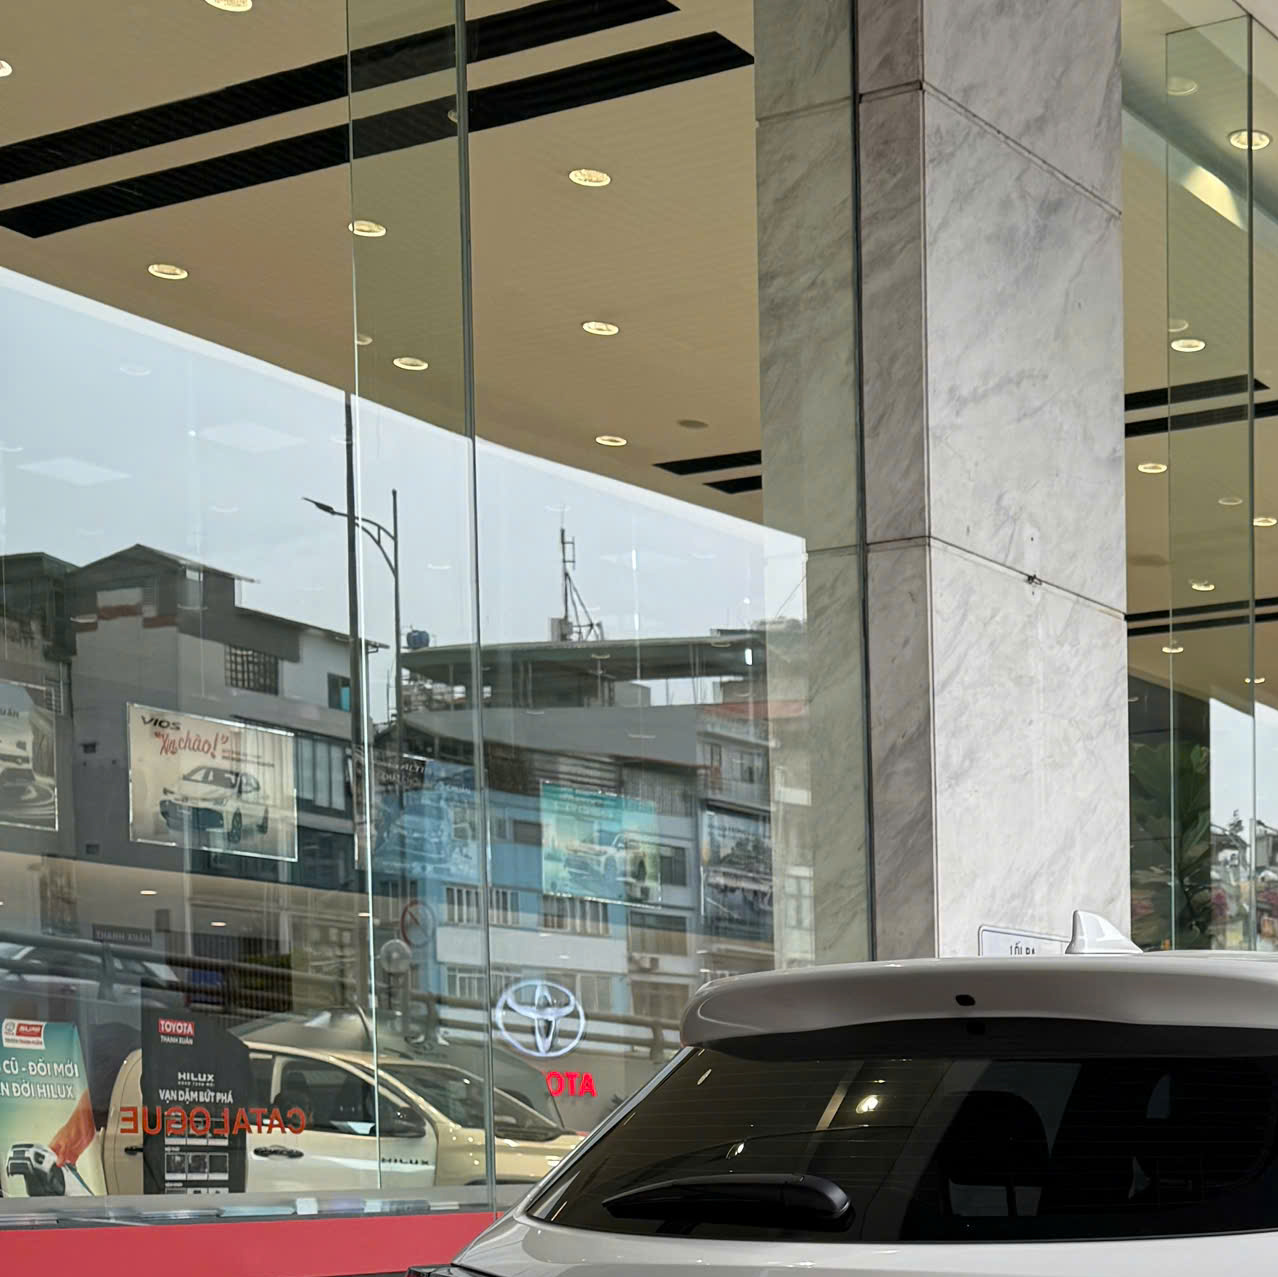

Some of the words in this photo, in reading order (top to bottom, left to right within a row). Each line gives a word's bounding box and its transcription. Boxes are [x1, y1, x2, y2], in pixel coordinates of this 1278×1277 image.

[141, 715, 182, 732] VIOS
[160, 1020, 194, 1035] TOYOTA
[2, 1056, 19, 1075] CŨ
[53, 1059, 79, 1078] MỚI
[177, 1071, 215, 1082] HILUX
[544, 1070, 599, 1098] OTA
[12, 1079, 34, 1097] ĐỜI
[36, 1083, 74, 1099] HILUX
[159, 1088, 178, 1104] VẠN
[215, 1089, 234, 1104] PHÁ
[381, 1156, 430, 1166] HILUX
